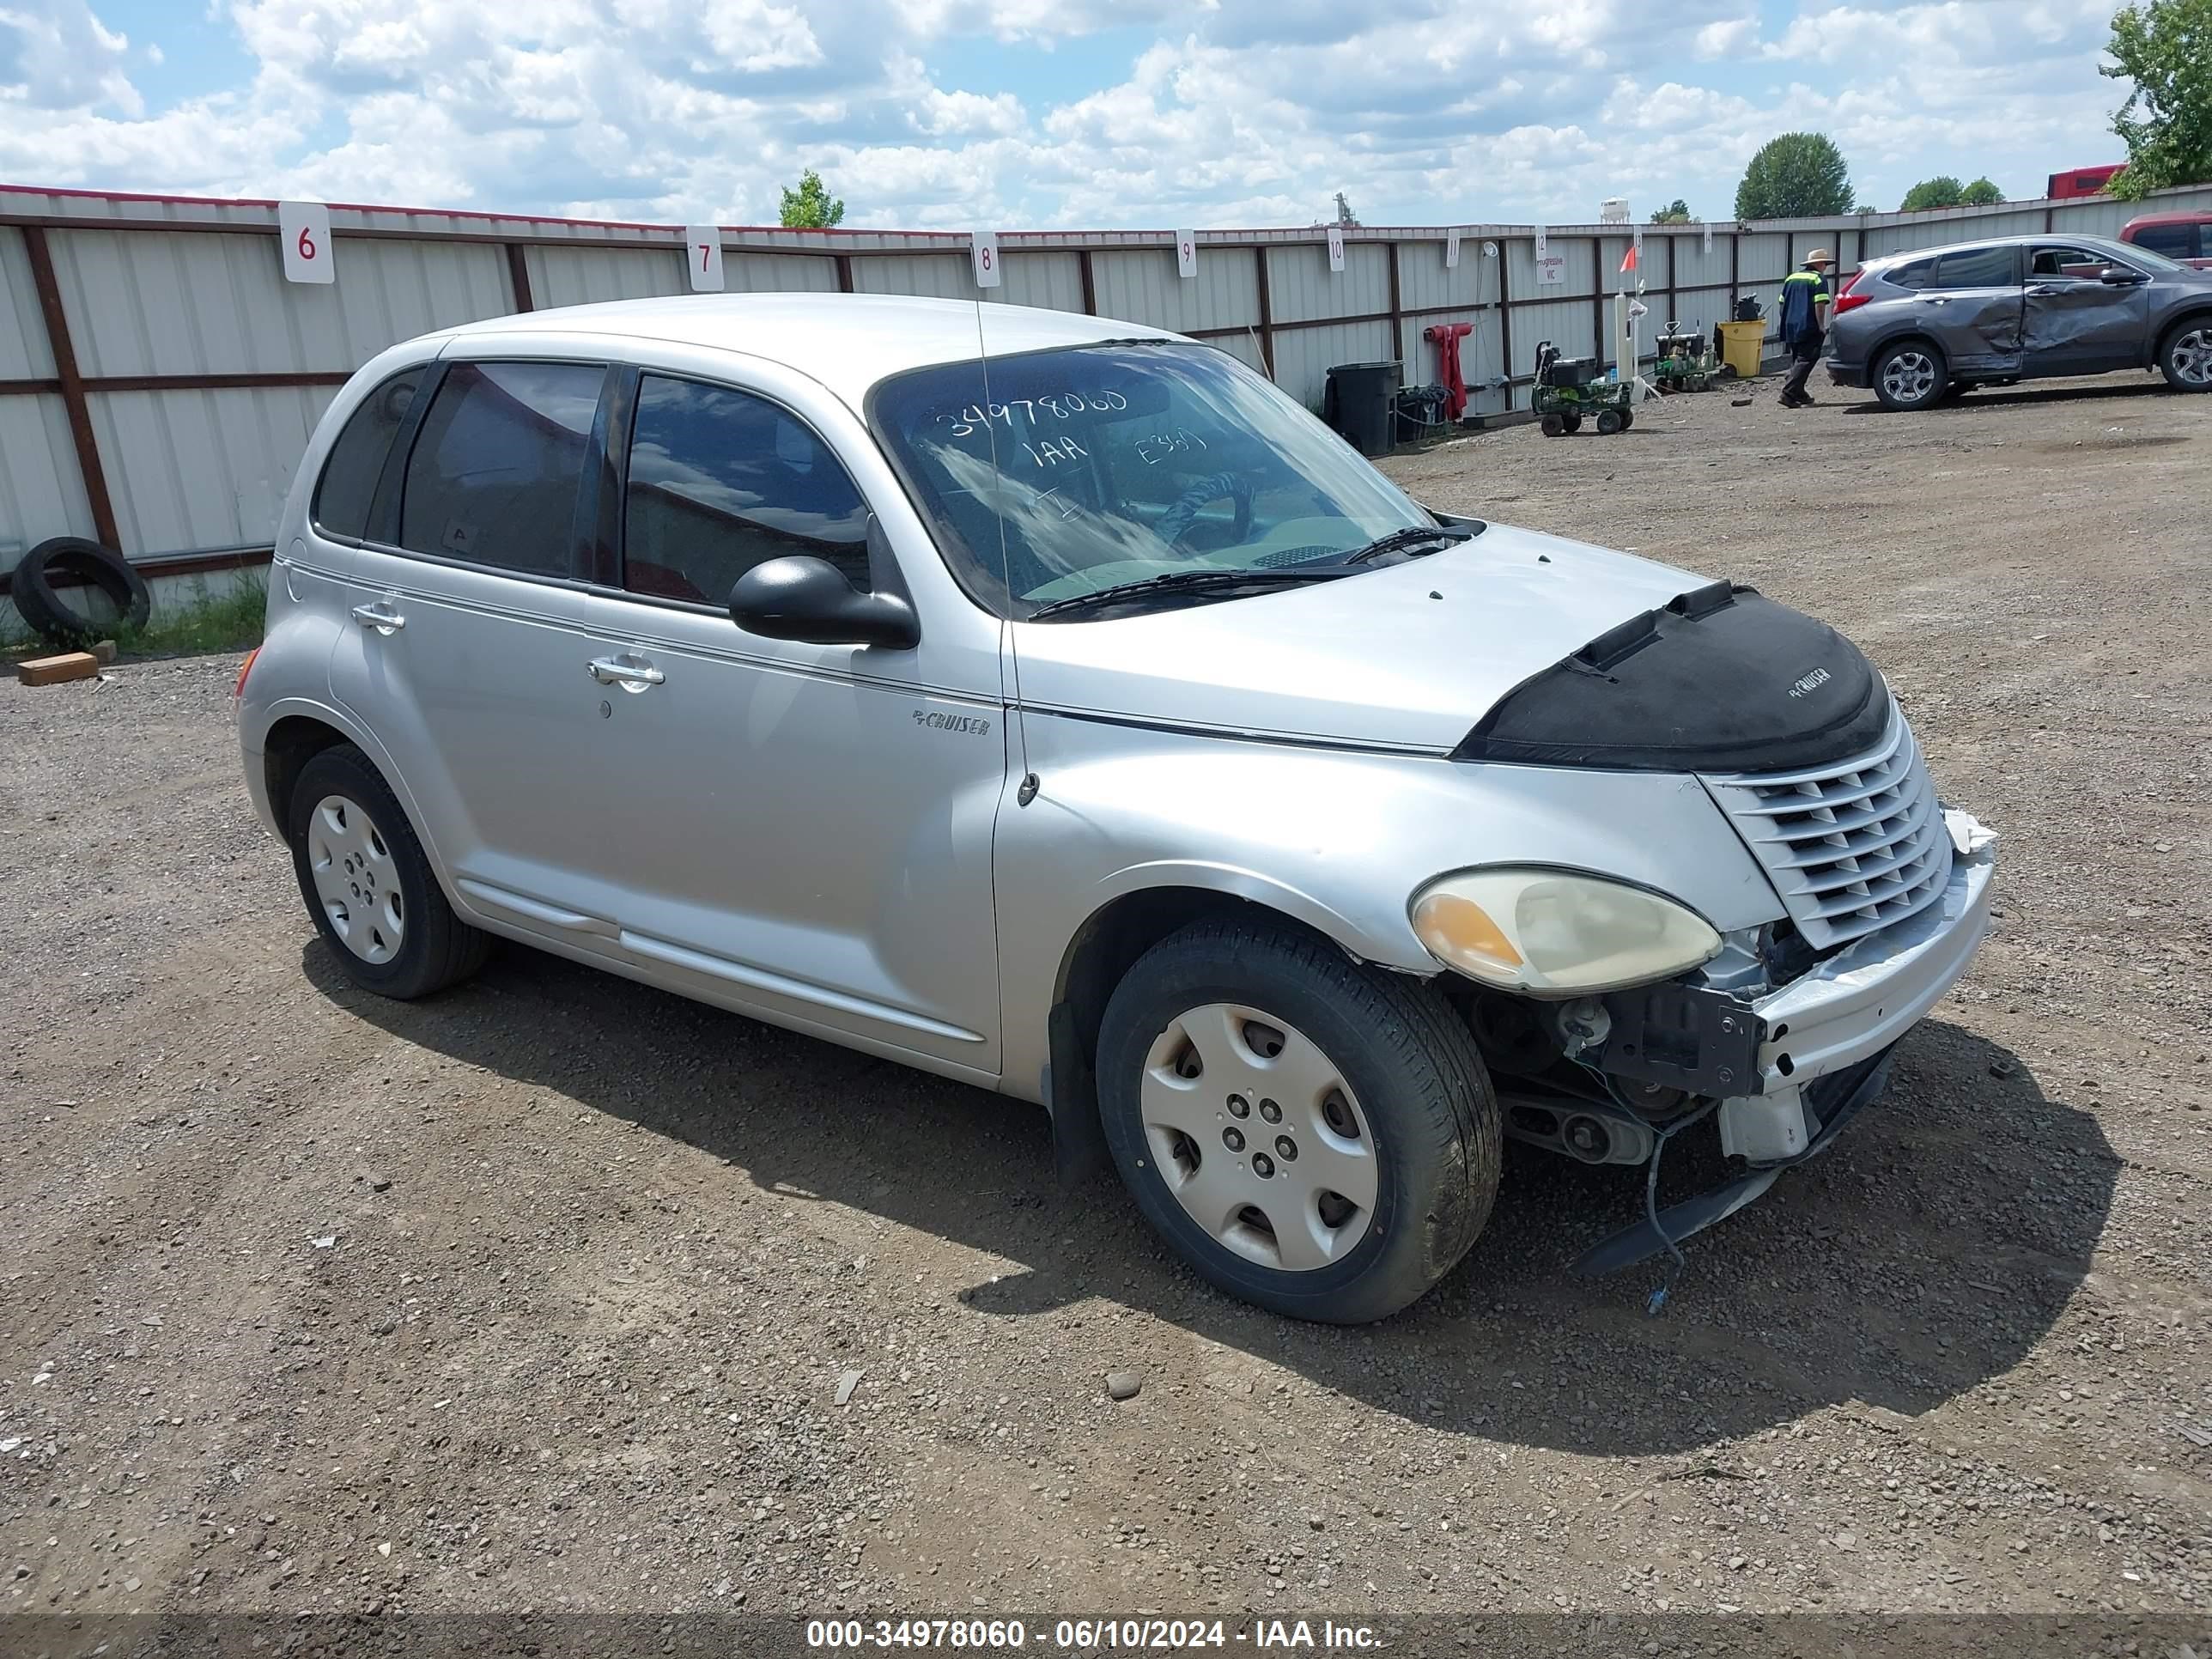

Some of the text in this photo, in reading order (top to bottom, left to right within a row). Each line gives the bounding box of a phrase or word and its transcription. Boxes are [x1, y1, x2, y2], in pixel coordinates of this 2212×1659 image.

[299, 227, 315, 259] 6
[1331, 240, 1341, 259] 10
[1449, 240, 1456, 257] 11
[1538, 235, 1545, 251] 12
[1635, 234, 1642, 248] 13
[699, 245, 710, 272] 7
[982, 247, 990, 270] 8
[1184, 242, 1190, 262] 9
[936, 390, 1127, 436] 34978060
[926, 712, 990, 735] CRUISER
